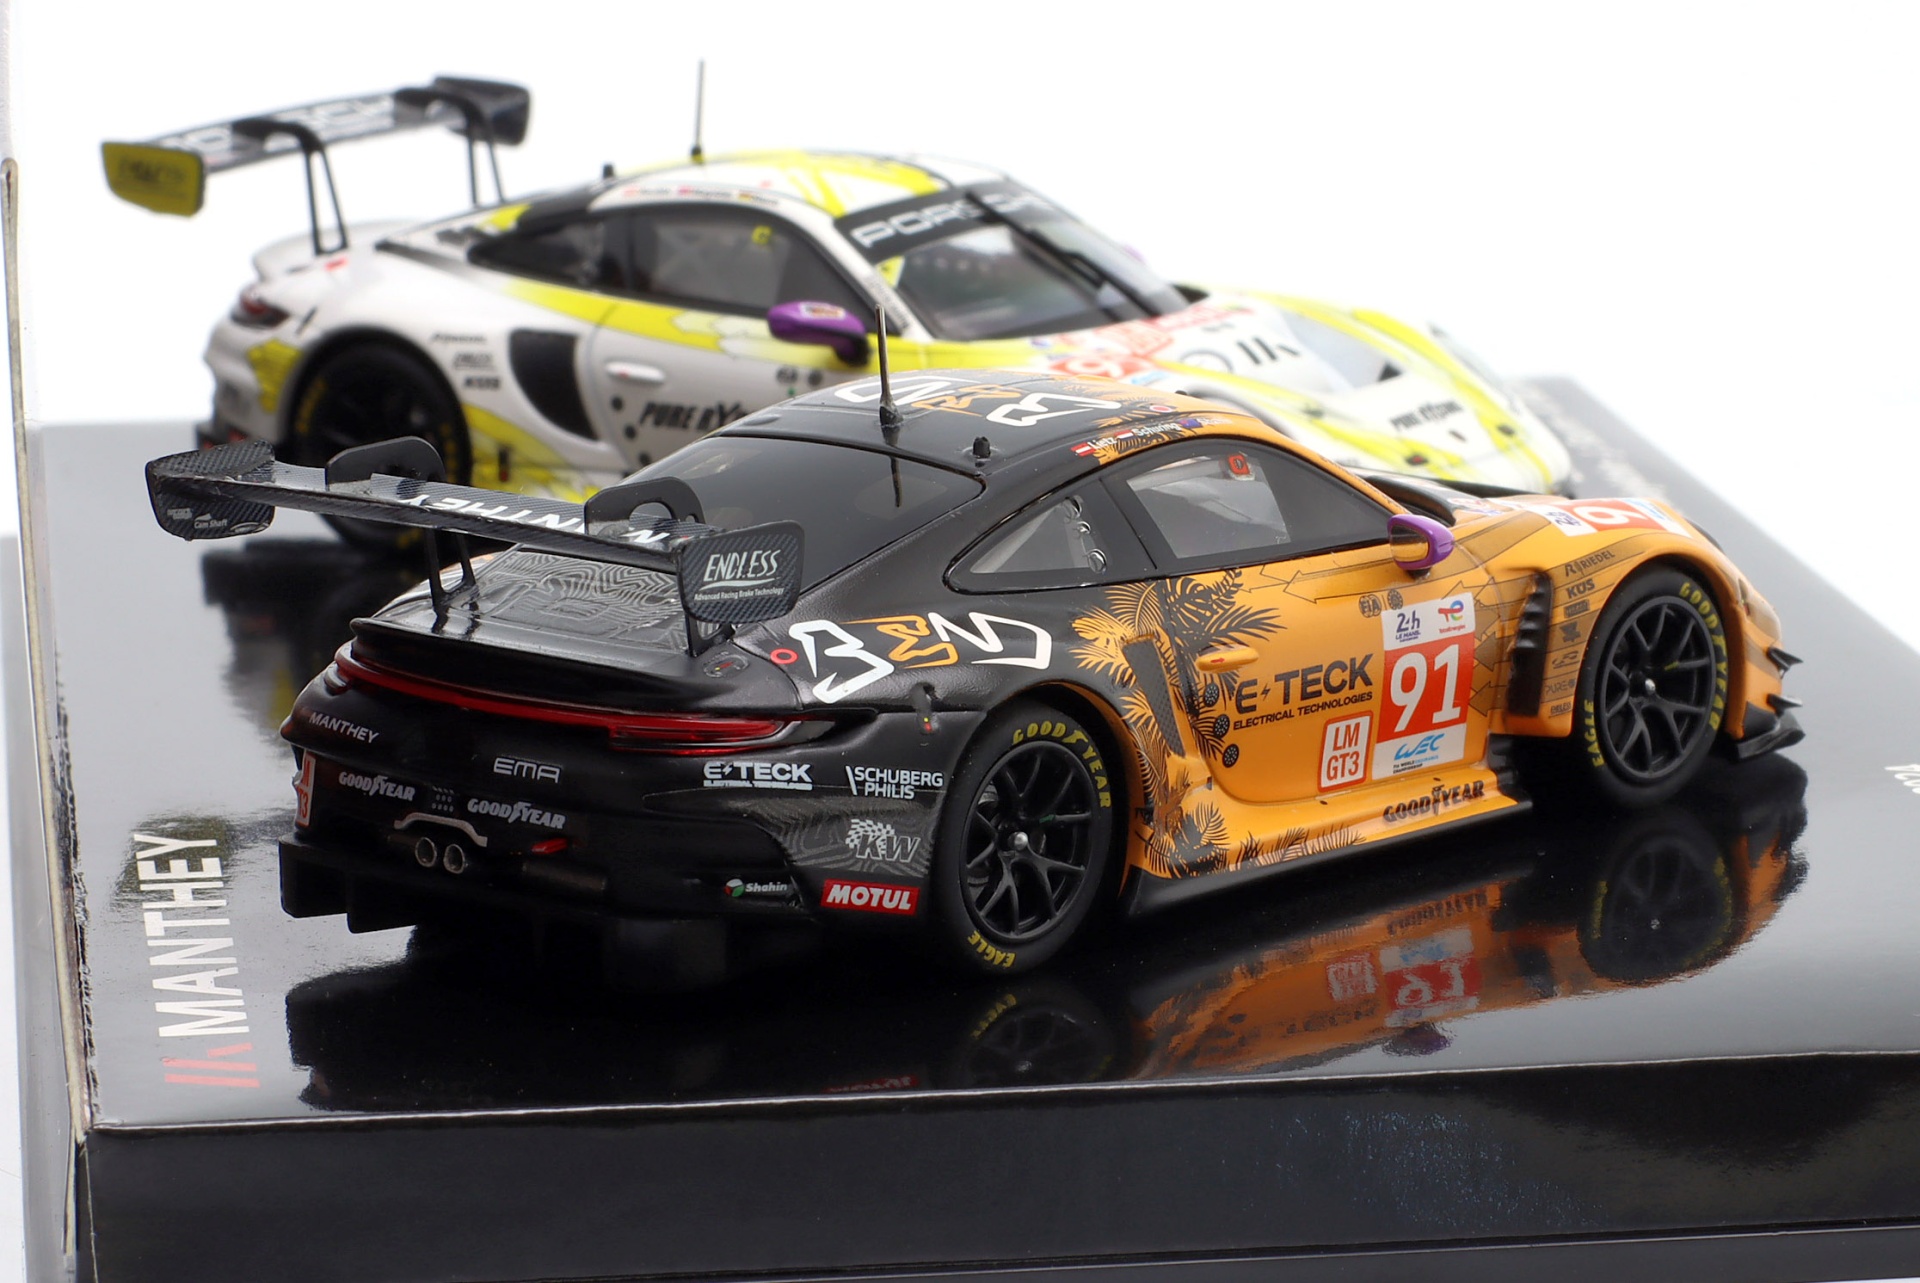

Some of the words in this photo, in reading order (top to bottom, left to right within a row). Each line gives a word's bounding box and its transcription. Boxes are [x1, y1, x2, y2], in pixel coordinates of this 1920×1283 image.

[1087, 434, 1117, 451] Lietz
[1131, 421, 1182, 437] Schuring
[703, 549, 781, 582] ENDLESS
[1580, 550, 1616, 569] RIEDEL
[694, 593, 720, 601] Advanced
[720, 591, 739, 600] Racing
[739, 589, 754, 597] Brake
[755, 587, 785, 596] Technology
[1396, 610, 1420, 633] 24h
[1390, 644, 1461, 733] 91
[1233, 709, 1295, 731] ELECTRICAL
[1297, 691, 1373, 716] TECHNOLOGIES
[309, 712, 379, 743] MANTHEY
[1332, 721, 1361, 751] LM
[1584, 699, 1605, 767] EAGLE
[1394, 733, 1445, 760] WEC
[854, 767, 944, 787] SCHUBERG
[1012, 721, 1112, 808] GOODYEAR
[1326, 750, 1360, 781] GT3
[339, 772, 416, 801] GOODYEAR
[864, 783, 916, 799] PHILIS
[1383, 781, 1485, 823] GOODYEAR
[467, 798, 567, 830] GOODYEAR
[855, 832, 921, 863] KW
[746, 882, 788, 893] Shahin
[826, 885, 912, 910] MOTUL
[133, 833, 250, 1038] MANTHEY
[967, 930, 1017, 968] EAGLE
